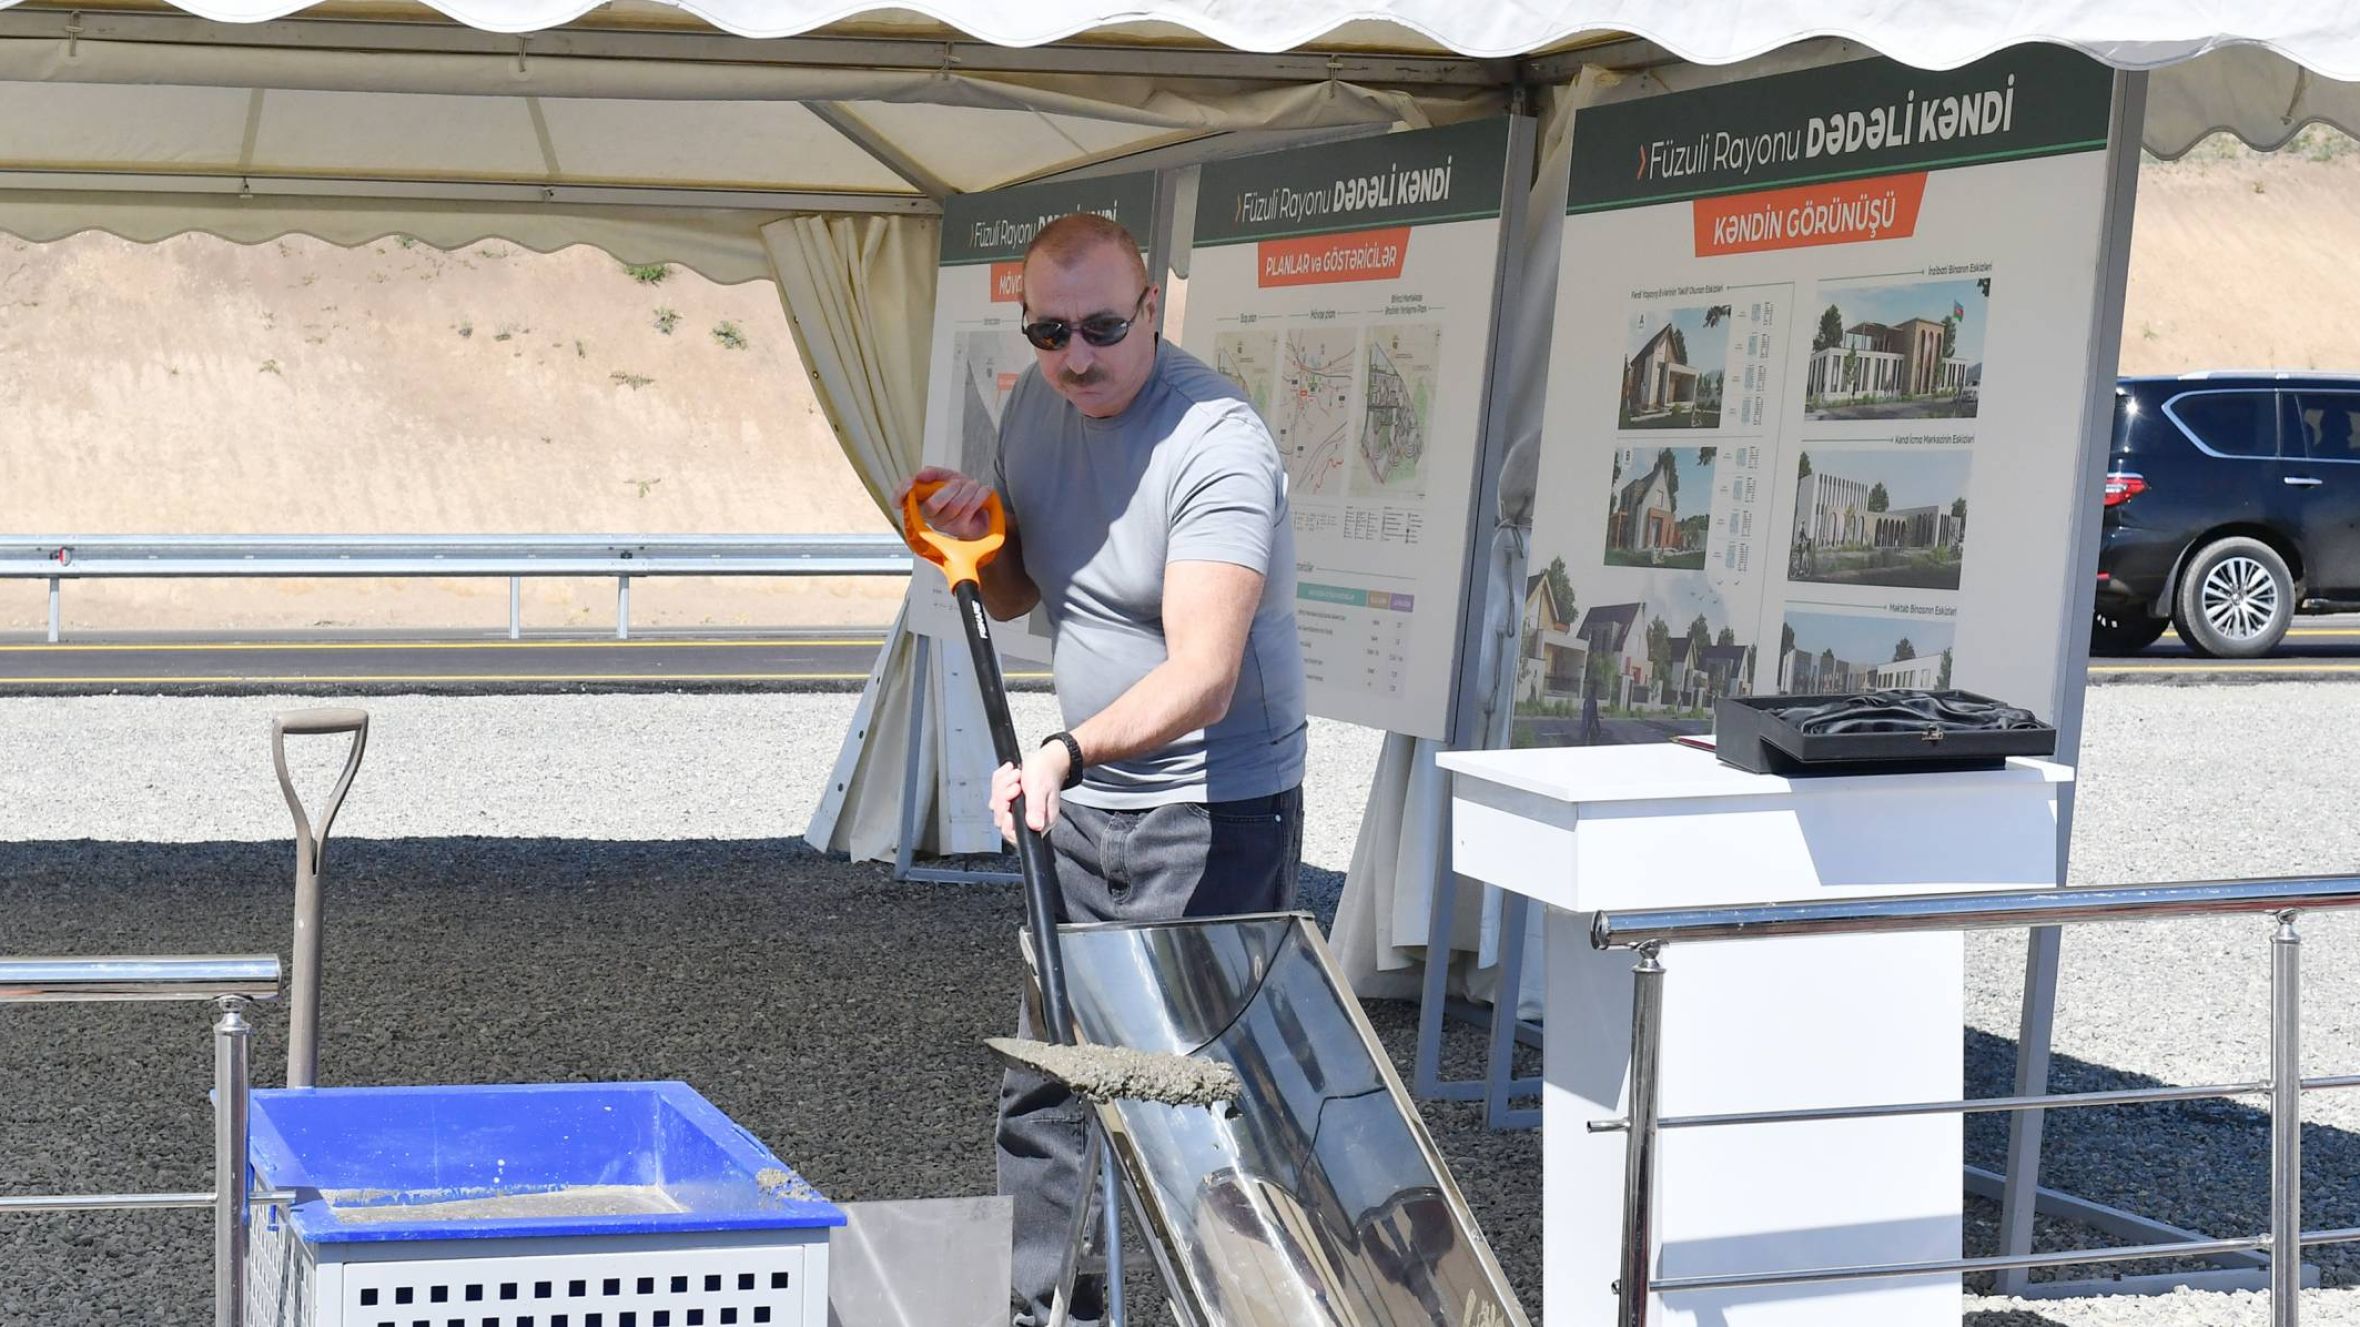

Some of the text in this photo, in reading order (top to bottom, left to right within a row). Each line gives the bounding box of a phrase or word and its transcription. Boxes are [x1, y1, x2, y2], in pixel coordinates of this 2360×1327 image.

[1649, 73, 2016, 180] Füzuli Rayonu DƏDƏLİ KƏNDİ
[1242, 155, 1453, 223] Füzuli Rayonu DƏDƏLİ KƏNDİ
[974, 219, 1001, 248] Füzuli
[1713, 190, 1897, 245] KƏNDİN GÖRÜNÜŞÜ
[1265, 253, 1310, 276] PLANLAR
[1323, 240, 1398, 272] GÖSTƏRİCİLƏR
